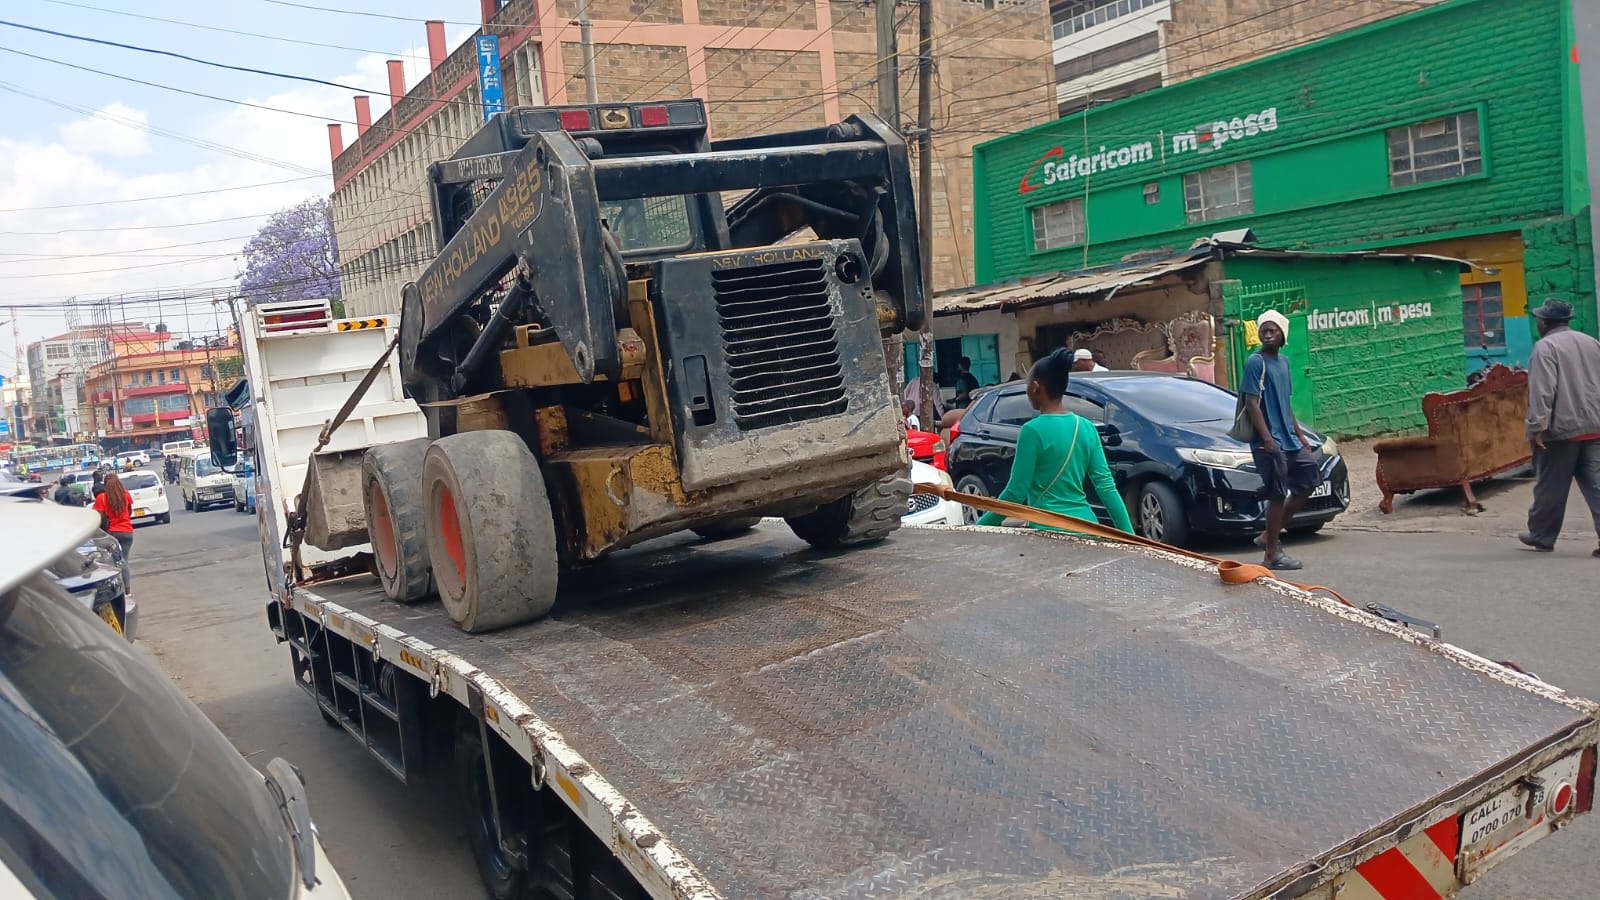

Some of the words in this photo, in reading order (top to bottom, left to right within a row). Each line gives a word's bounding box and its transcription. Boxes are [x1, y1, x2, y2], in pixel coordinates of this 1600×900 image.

[480, 39, 499, 90] STAR
[1044, 141, 1153, 185] Safaricom
[442, 215, 502, 286] HOLLAND
[1470, 800, 1502, 825] CALL:
[1472, 818, 1499, 844] 0700
[1502, 804, 1522, 826] 070
